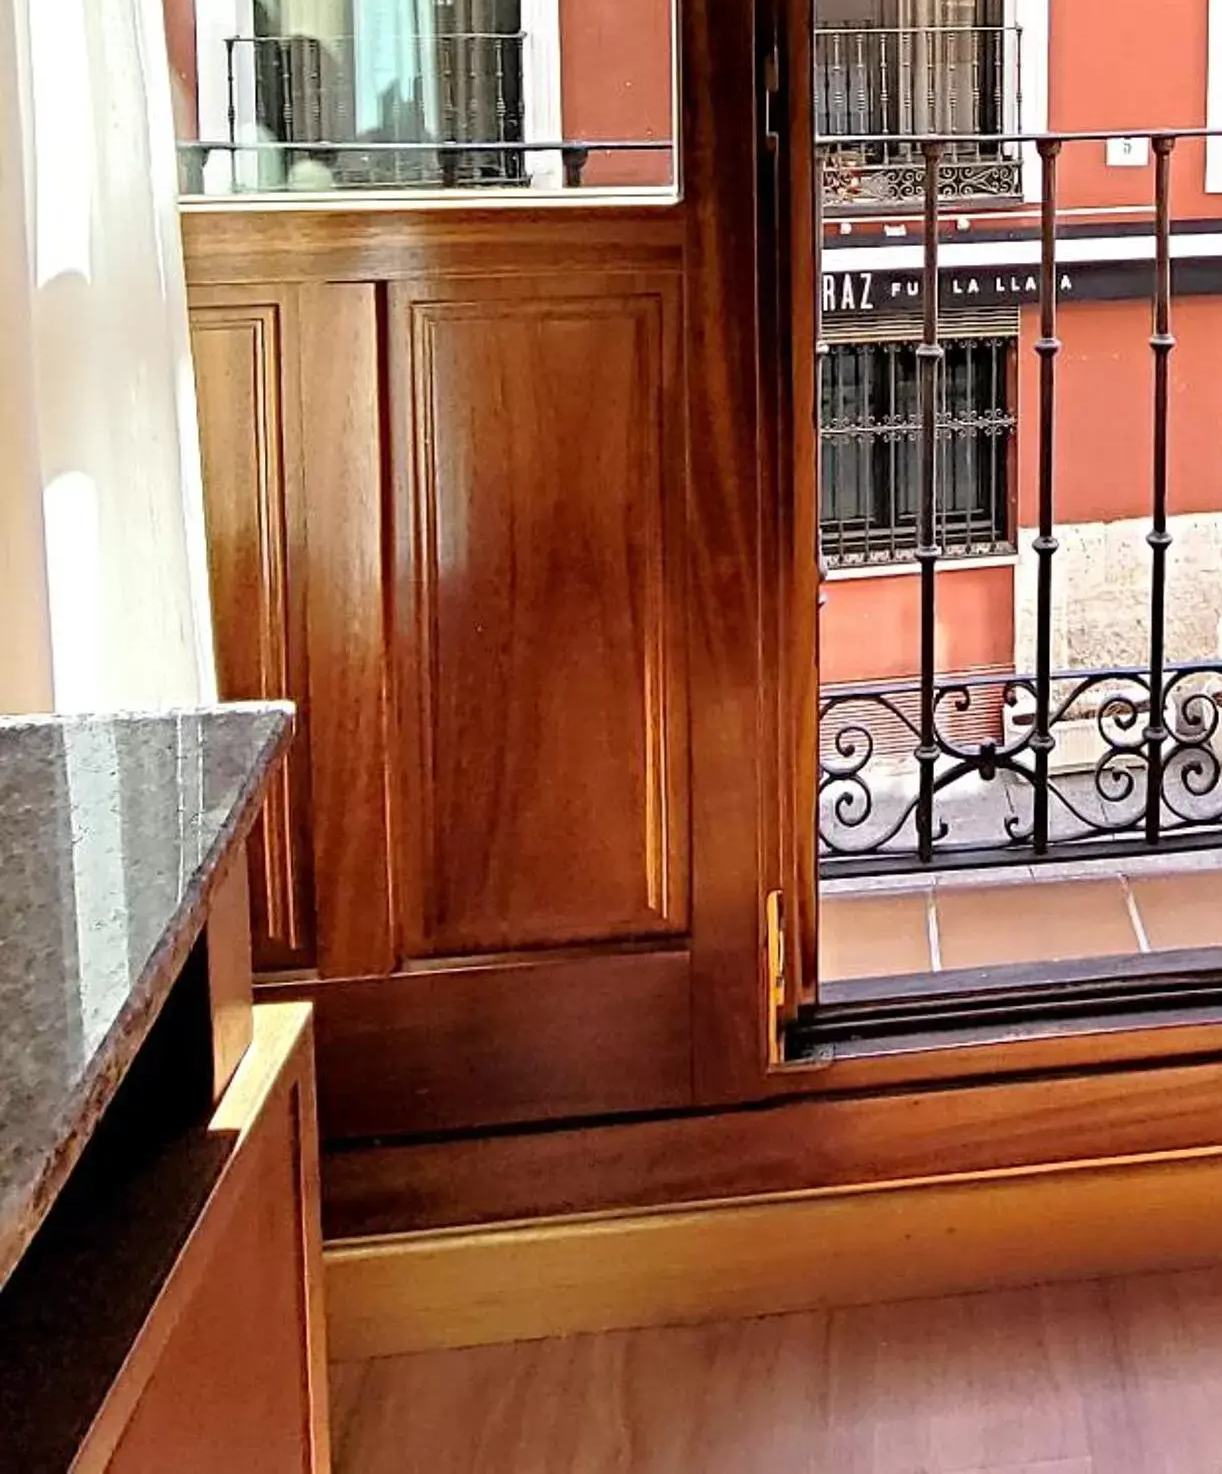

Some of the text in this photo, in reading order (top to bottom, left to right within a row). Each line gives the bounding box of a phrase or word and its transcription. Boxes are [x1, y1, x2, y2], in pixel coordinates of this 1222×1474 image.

[891, 281, 920, 298] FU
[953, 278, 980, 294] LA
[996, 273, 1073, 293] LLAA
